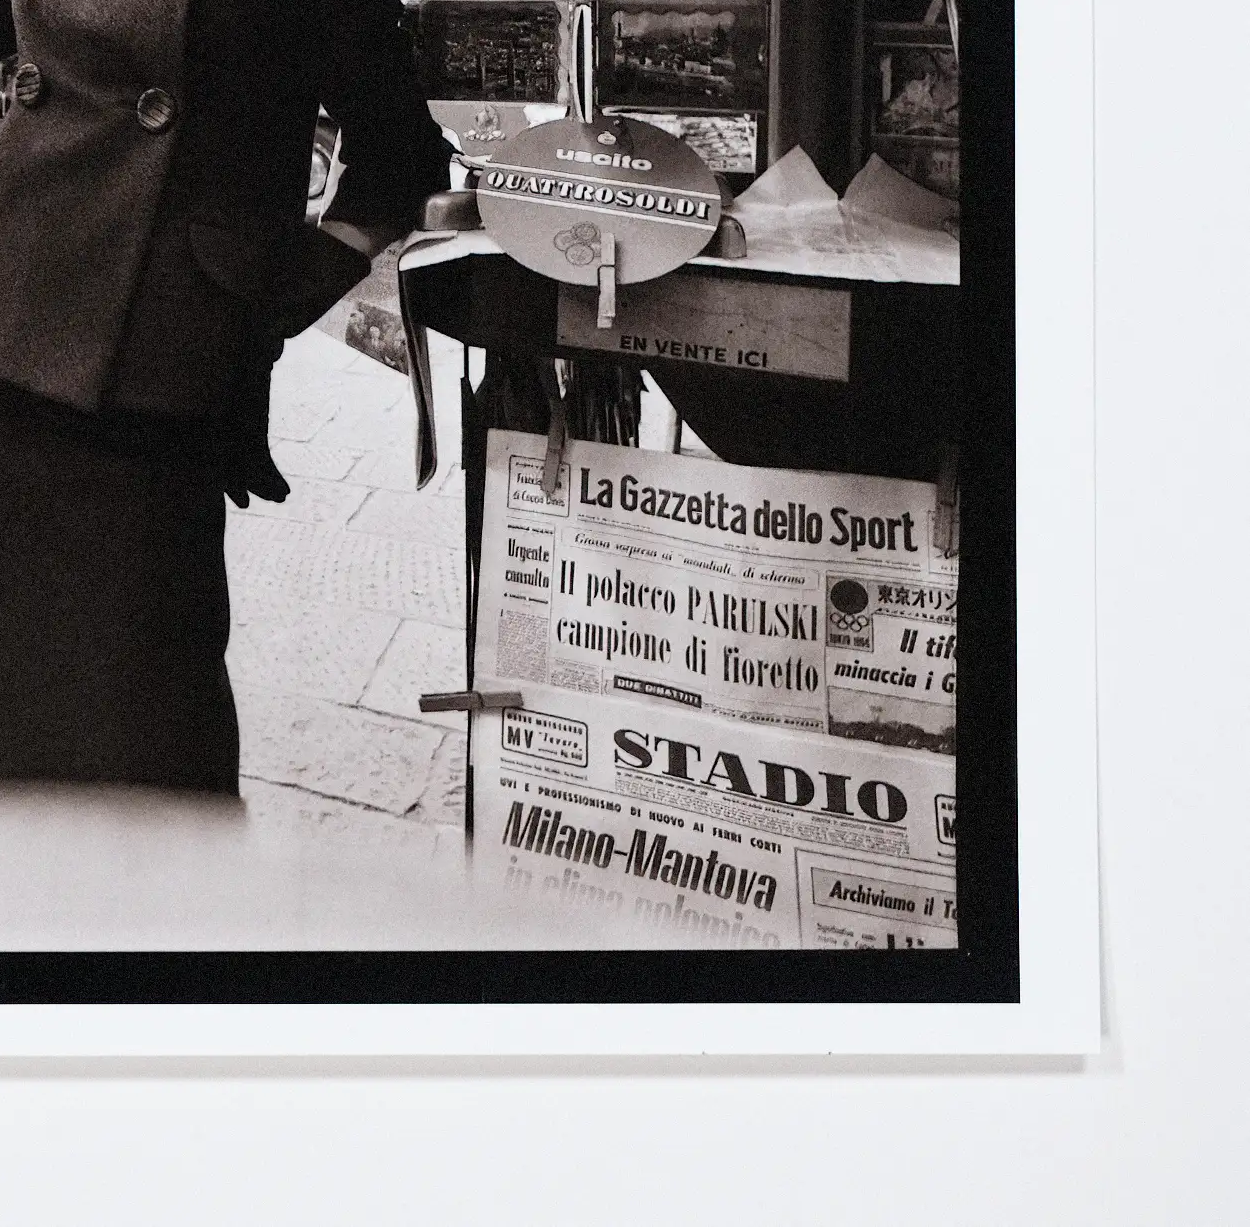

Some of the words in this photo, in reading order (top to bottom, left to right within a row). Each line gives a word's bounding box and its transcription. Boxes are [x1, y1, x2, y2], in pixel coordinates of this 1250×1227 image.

[556, 148, 652, 171] uscito
[486, 168, 711, 220] QUATTROSOLDI
[620, 335, 648, 352] EN
[654, 338, 726, 363] VENTE
[737, 349, 768, 369] ICI
[580, 467, 613, 508] La
[619, 474, 747, 536] Gazzetta
[753, 499, 823, 544] dello
[829, 506, 918, 552] Sport
[508, 538, 549, 563] Urgente
[505, 568, 549, 589] consulto
[742, 567, 754, 579] di
[560, 560, 576, 595] Il
[586, 568, 676, 615] polacco
[688, 584, 818, 641] PARULSKI
[556, 616, 671, 664] campione
[685, 635, 707, 676] di
[723, 644, 819, 692] fioretto
[900, 628, 918, 654] Il
[617, 678, 642, 692] DUE
[834, 659, 917, 688] minaccia
[924, 671, 934, 690] i
[613, 728, 908, 822] STADIO
[538, 785, 622, 813] PROFESSIONISMO
[630, 806, 641, 817] DI
[649, 811, 685, 828] NUOVO
[692, 822, 704, 834] AI
[712, 826, 742, 844] FERRI
[750, 836, 782, 854] CORTI
[829, 880, 916, 913] Archiviamo
[924, 896, 935, 916] il
